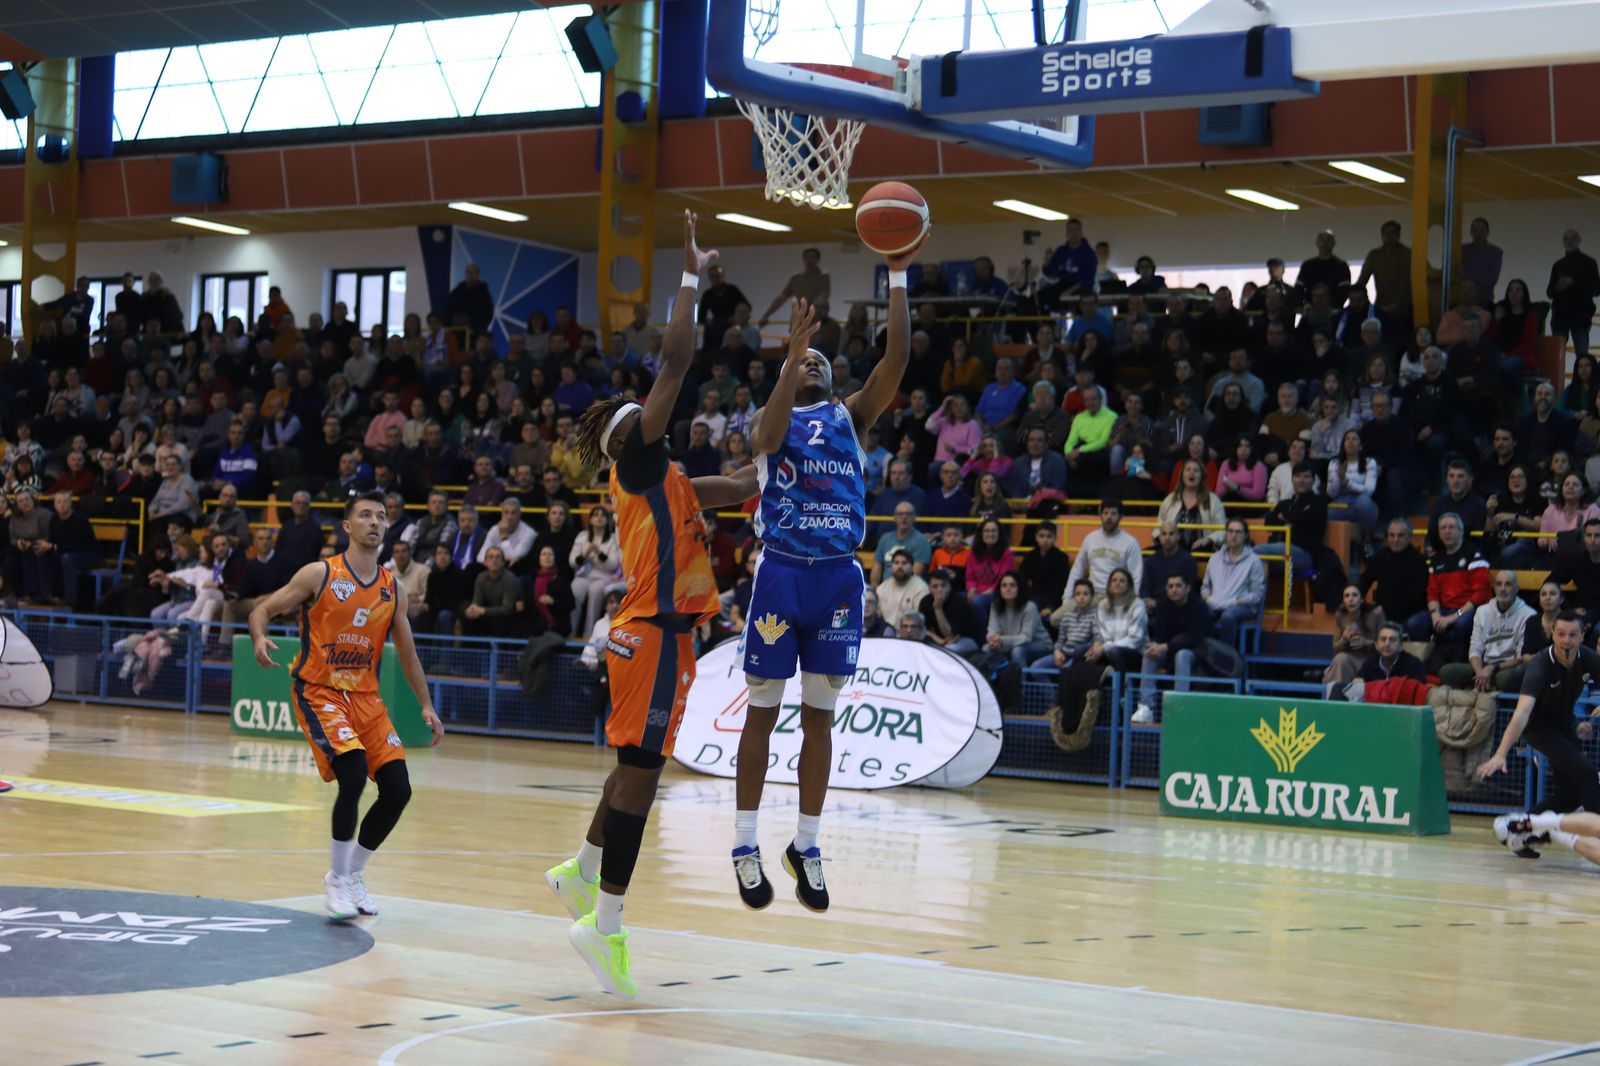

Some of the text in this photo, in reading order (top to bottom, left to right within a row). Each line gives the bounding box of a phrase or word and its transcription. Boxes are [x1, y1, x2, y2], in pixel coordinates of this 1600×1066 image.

[1042, 46, 1153, 73] Schelde
[1042, 68, 1152, 97] Sports
[807, 420, 825, 446] 2
[803, 459, 856, 477] INNOVA
[799, 516, 852, 530] ZAMORA
[352, 607, 371, 628] 6
[828, 634, 859, 642] ZAMORA
[233, 698, 295, 732] CAJA
[775, 703, 924, 744] ZMORA
[693, 743, 912, 781] Dotes
[1165, 771, 1411, 826] CAJA RURAL
[0, 907, 293, 933] ZAM
[0, 925, 200, 946] DIPU
